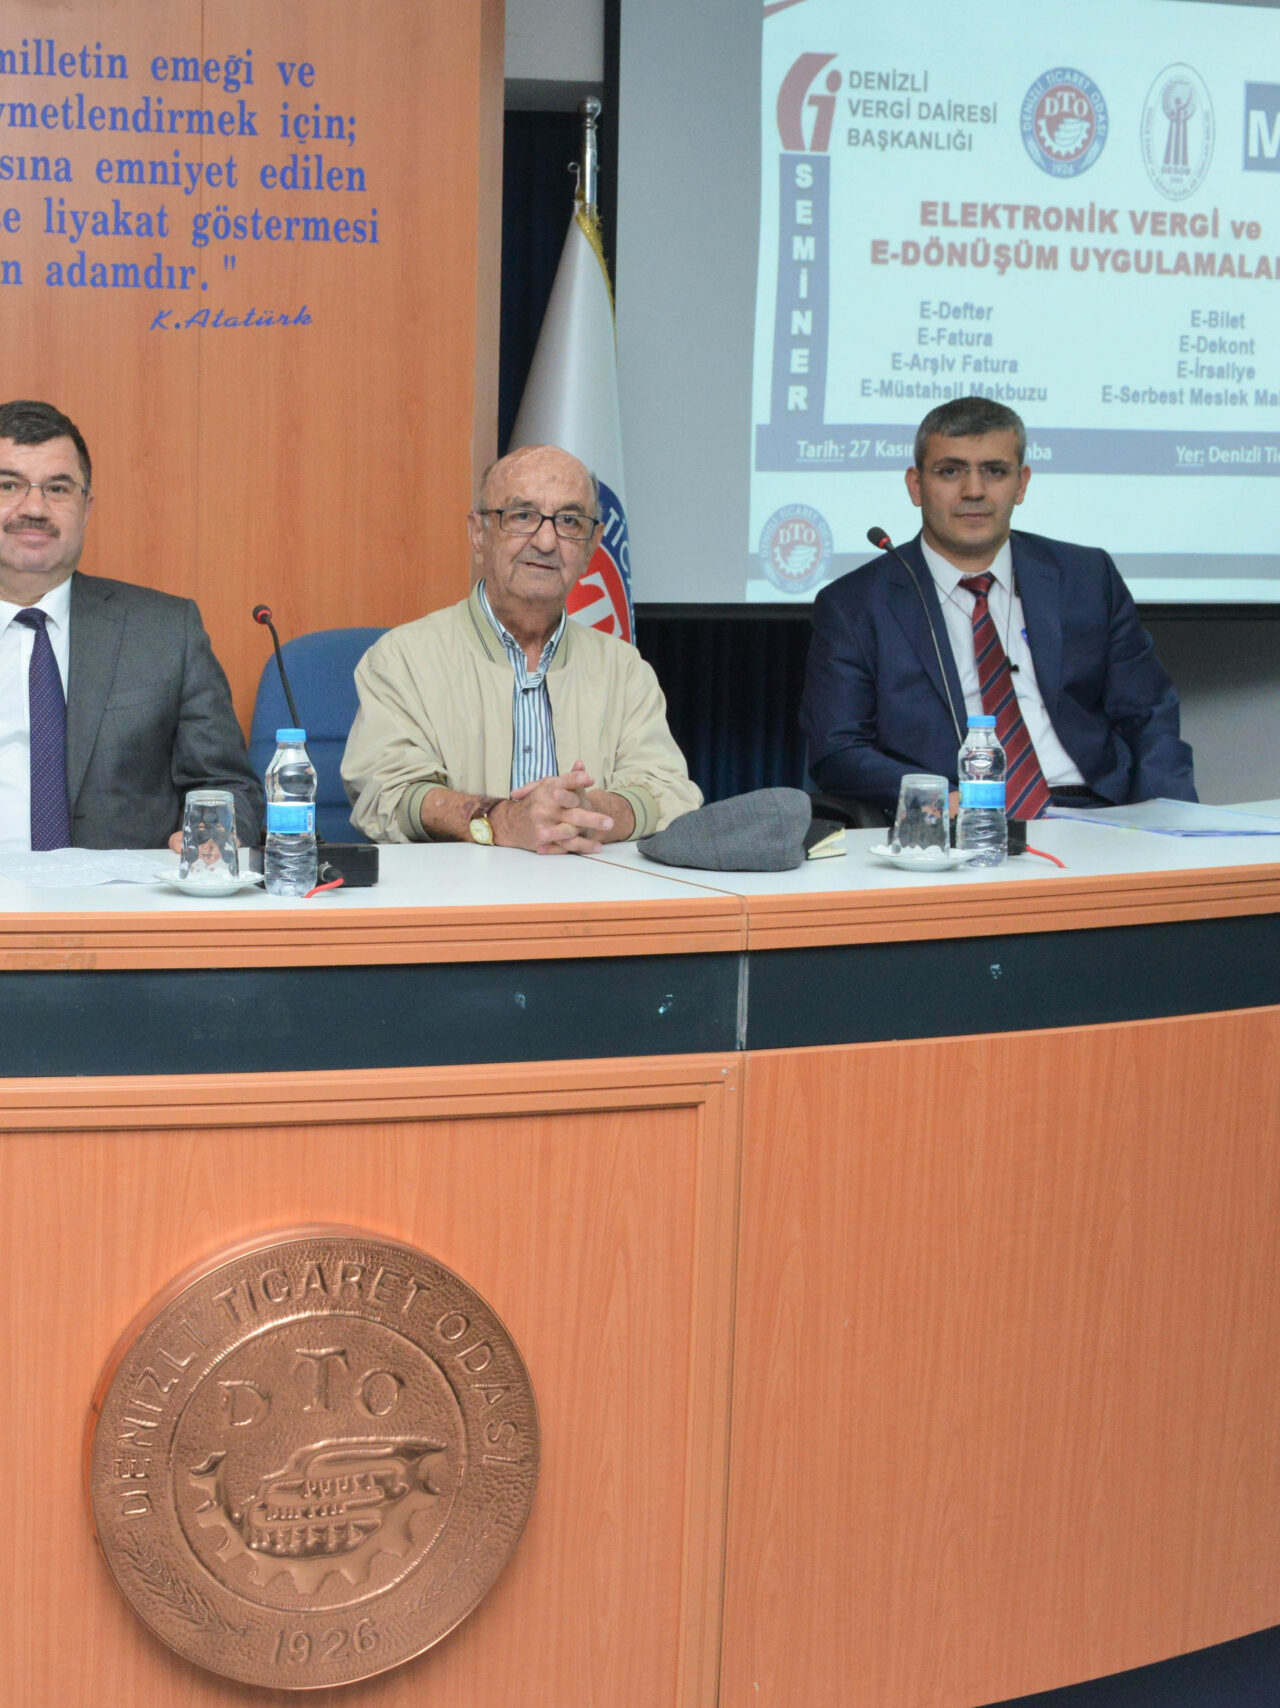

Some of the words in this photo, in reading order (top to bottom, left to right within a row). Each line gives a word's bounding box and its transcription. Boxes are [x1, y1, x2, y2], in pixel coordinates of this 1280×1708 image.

[150, 49, 254, 93] emeği
[276, 62, 316, 87] ve
[849, 68, 929, 92] DENİZLİ
[847, 97, 911, 120] VERGİ
[918, 99, 998, 124] DAİRESİ
[1044, 91, 1090, 117] DTO
[280, 101, 356, 147] için;
[847, 128, 973, 152] BAŞKANLIĞI
[95, 150, 237, 195] emniyet
[259, 153, 367, 192] edilen
[44, 197, 169, 244] liyakat
[191, 205, 379, 248] göstermesi
[919, 200, 1119, 234] ELEKTRONİK
[1128, 205, 1219, 239] VERGİ
[1229, 219, 1262, 241] ve
[870, 235, 1059, 276] E-DÖNÜŞÜM
[920, 301, 994, 321] E-Defter
[1190, 309, 1246, 329] E-Bilet
[917, 327, 993, 347] E-Fatura
[1179, 334, 1256, 355] E-Dekont
[891, 352, 956, 376] E-Arşiv
[962, 354, 1019, 374] Fatura
[1176, 357, 1256, 384] E-İrsaliye
[860, 378, 964, 399] E-Müstahsil
[1101, 385, 1185, 405] E-Serbest
[1189, 387, 1249, 407] Meslek
[796, 439, 846, 460] Tarih:
[849, 439, 871, 458] 27
[1175, 445, 1205, 465] Yer:
[1208, 445, 1261, 464] Denizli
[779, 523, 817, 545] DTO
[218, 1345, 407, 1428] DTO
[436, 1310, 519, 1466] ODASI
[271, 1616, 381, 1666] 1926
